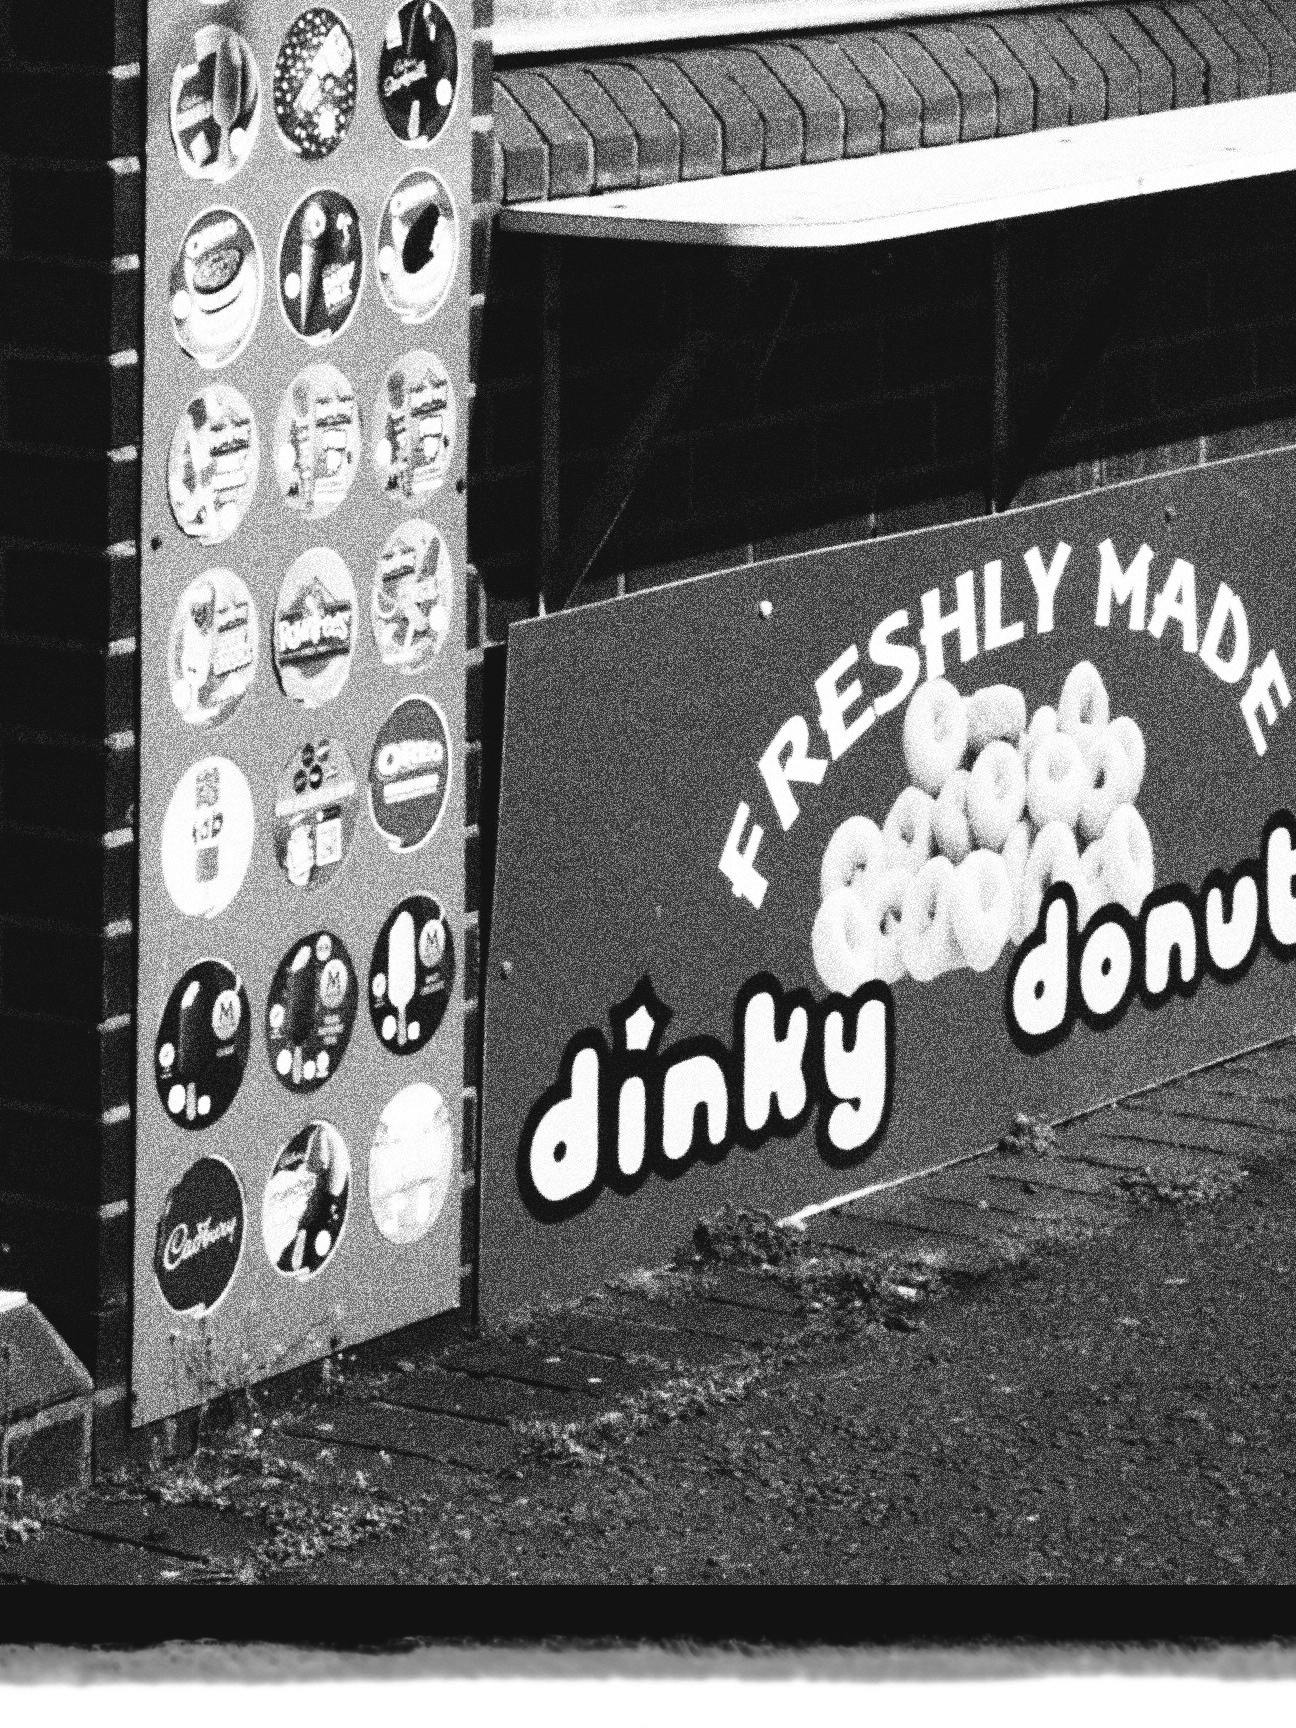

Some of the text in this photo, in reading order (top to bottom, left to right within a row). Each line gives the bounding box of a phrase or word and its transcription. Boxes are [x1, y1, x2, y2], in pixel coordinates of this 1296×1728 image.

[717, 537, 1296, 910] FRESHLY MADE
[522, 980, 894, 1214] dinky
[163, 1216, 239, 1271] Cadbury
